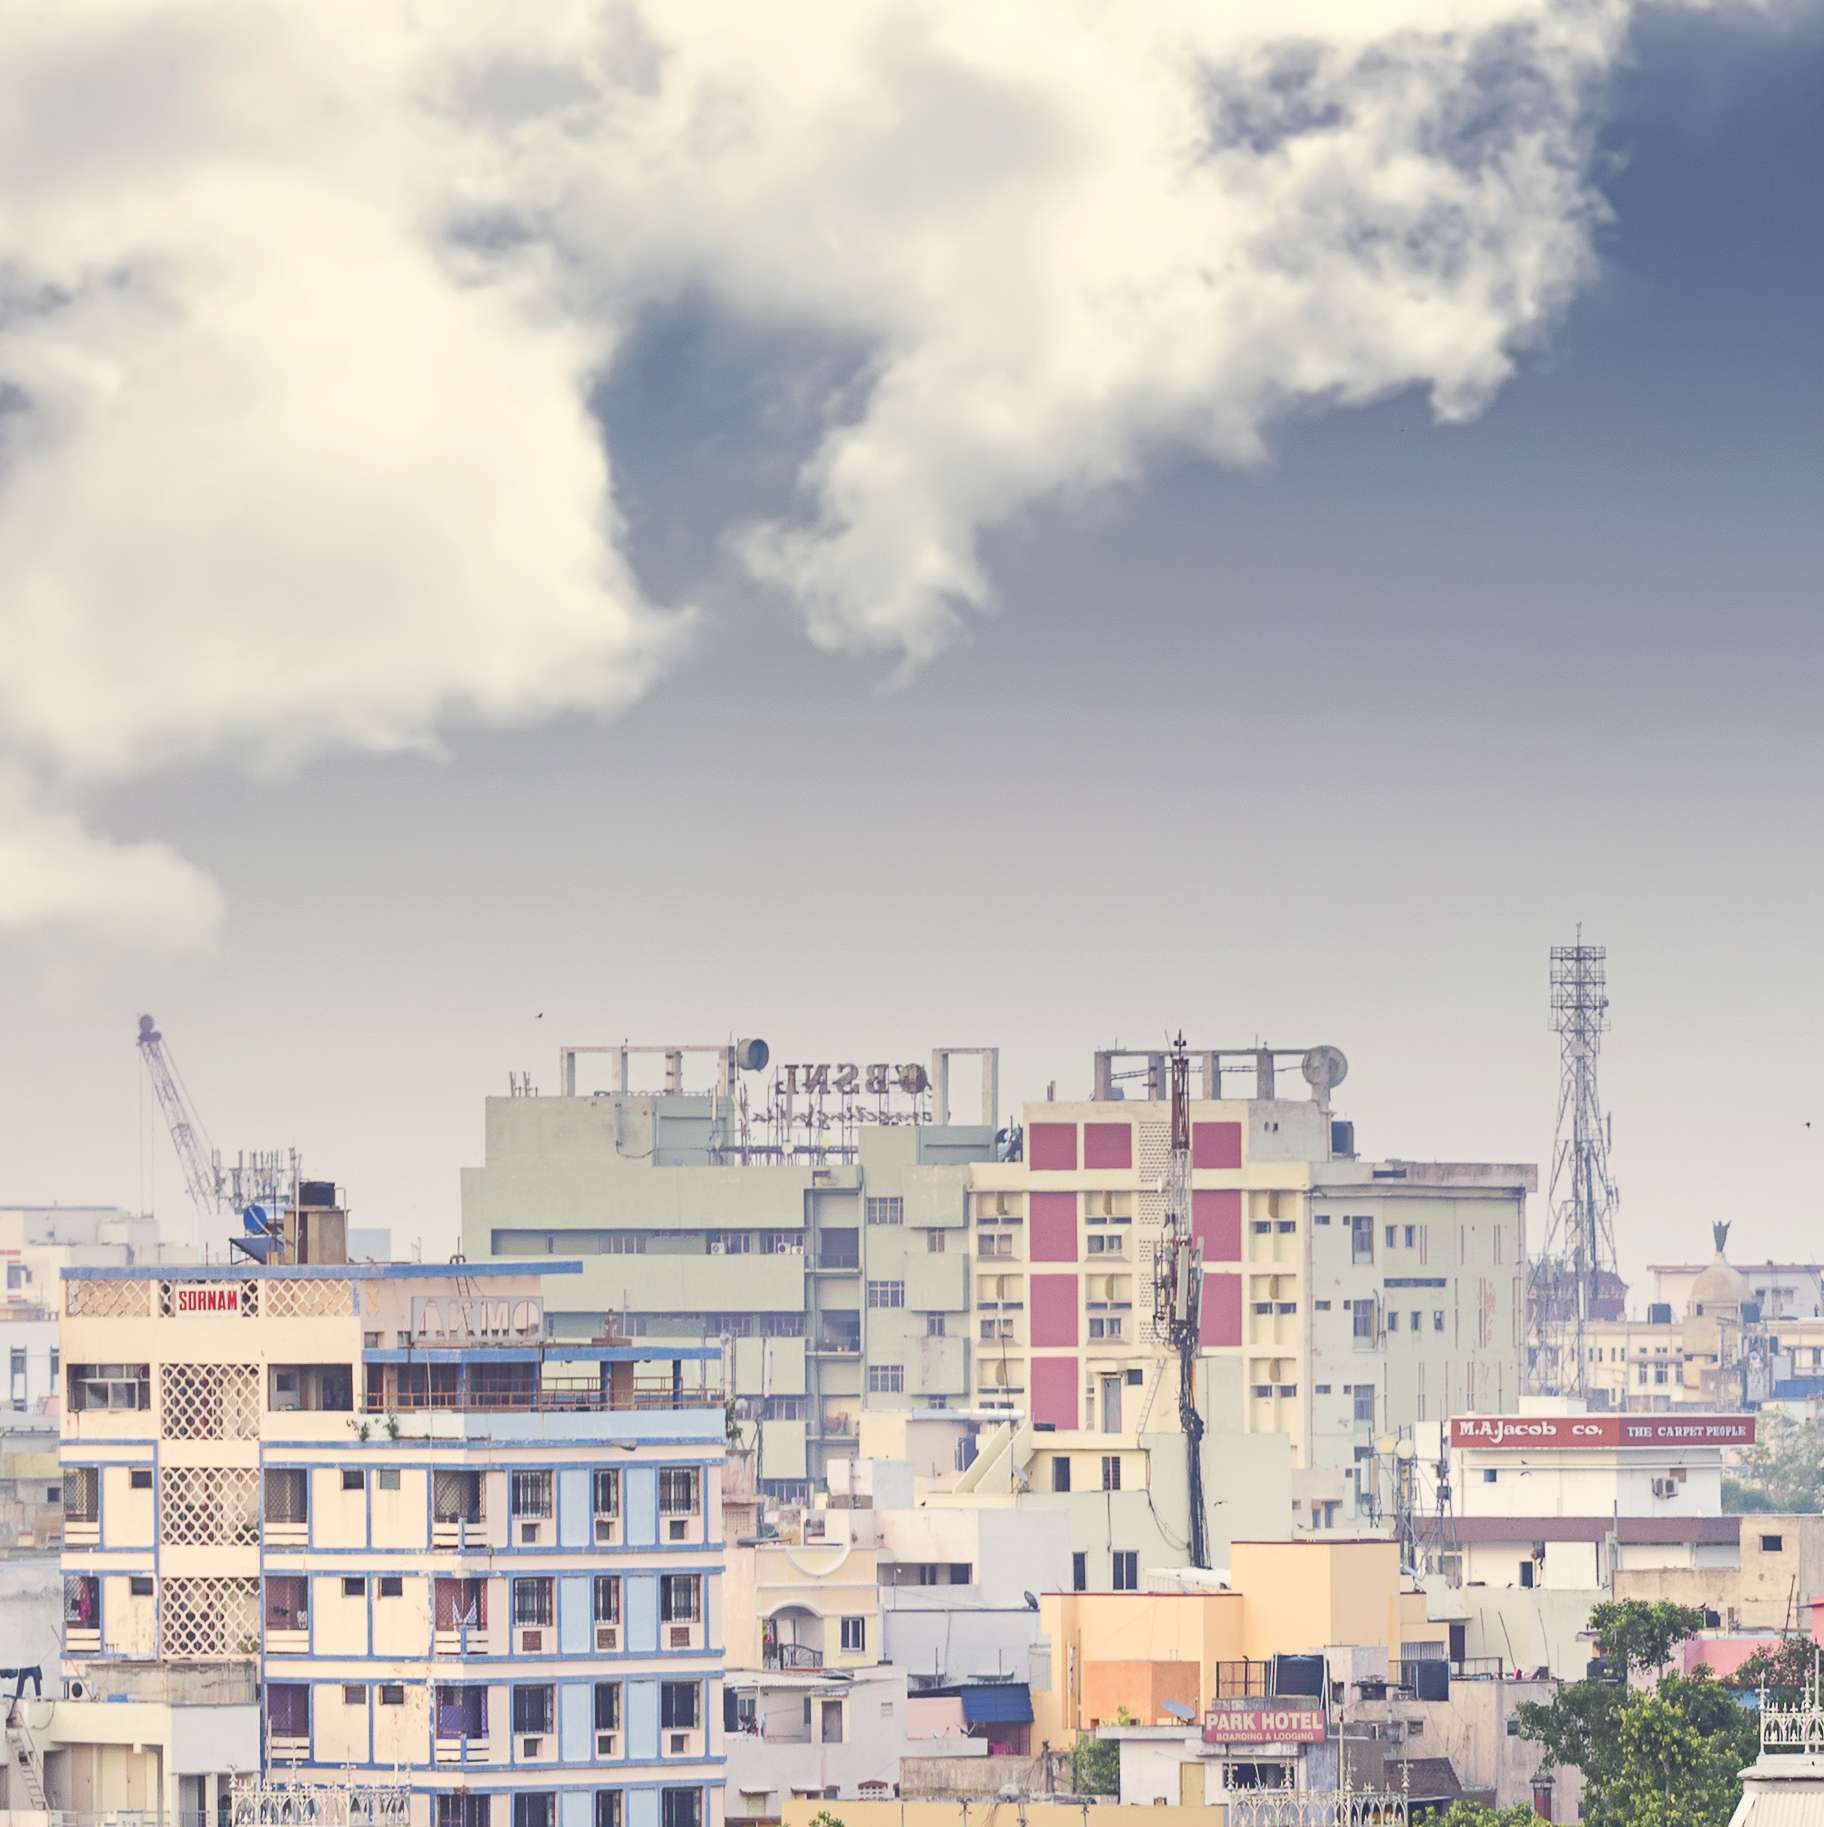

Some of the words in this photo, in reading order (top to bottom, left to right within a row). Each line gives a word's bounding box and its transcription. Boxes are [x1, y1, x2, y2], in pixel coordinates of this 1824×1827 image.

[179, 1289, 237, 1311] SORNAM
[1627, 1427, 1651, 1438] THE
[1657, 1427, 1704, 1438] CARPET
[1706, 1426, 1746, 1437] PEOPLE
[1206, 1713, 1257, 1730] PARK
[1261, 1712, 1323, 1730] HOTEL
[1216, 1732, 1262, 1740] BOARDING
[1273, 1732, 1314, 1740] LODGING
